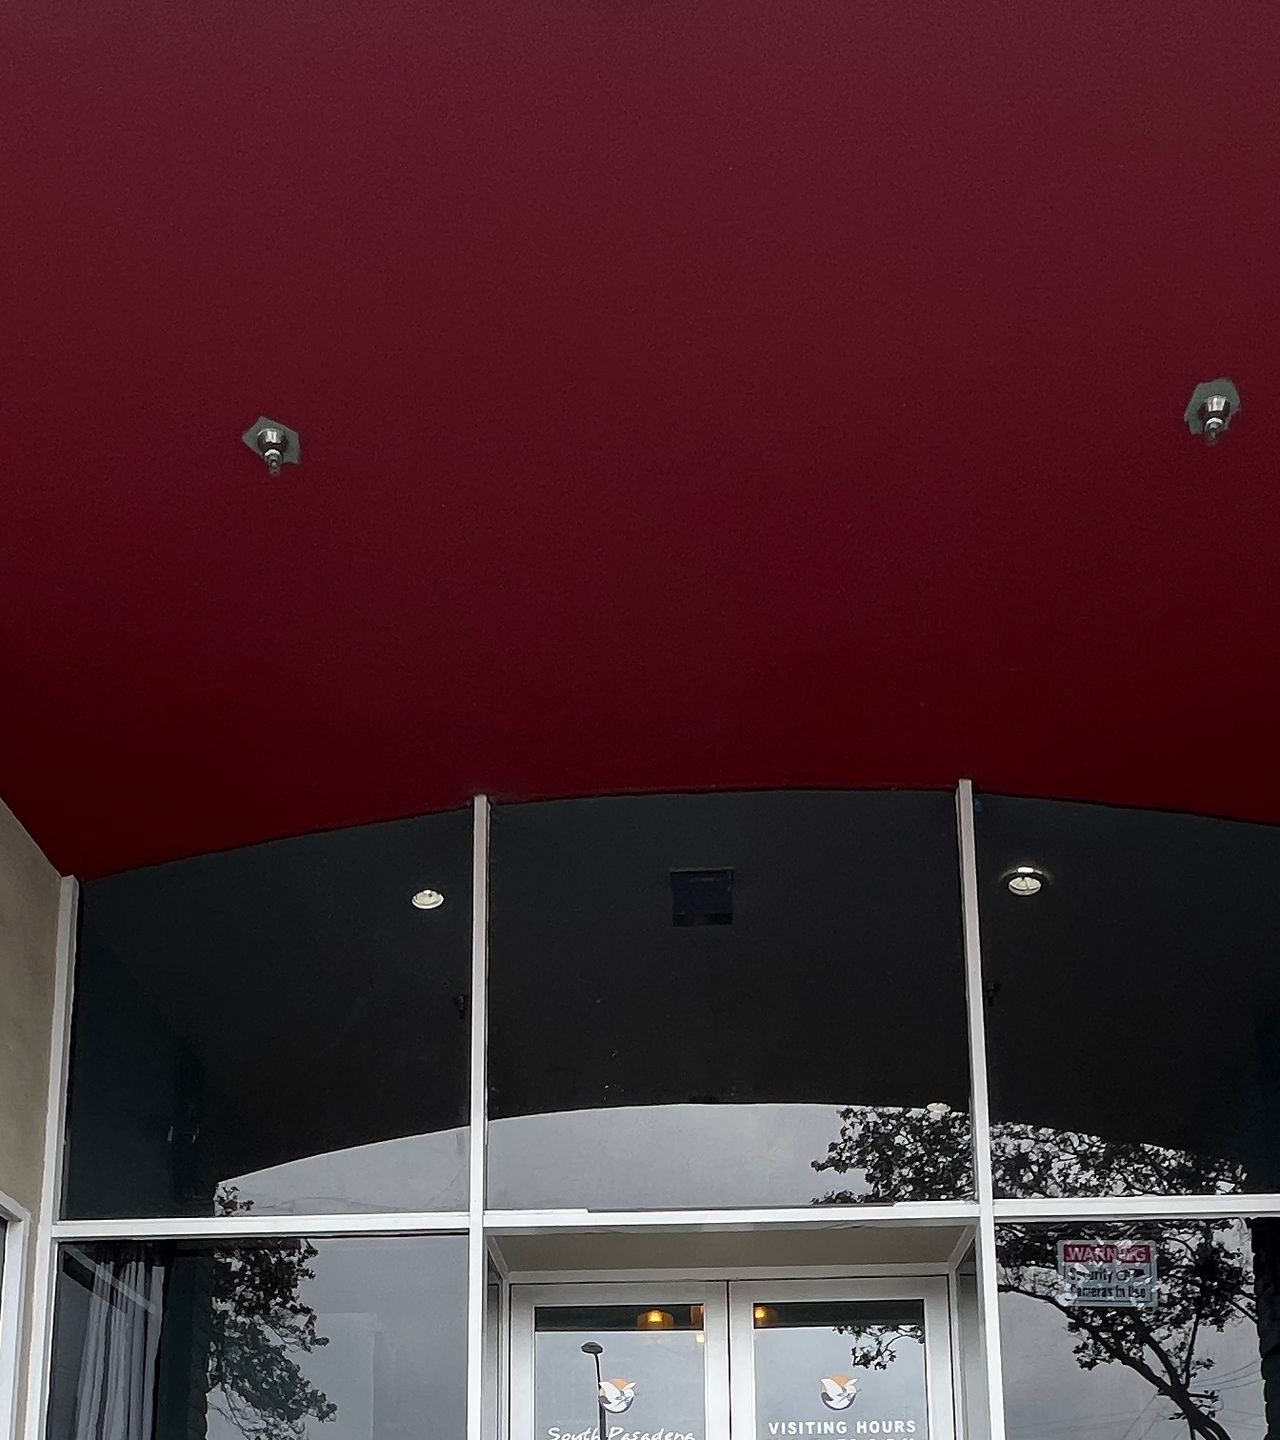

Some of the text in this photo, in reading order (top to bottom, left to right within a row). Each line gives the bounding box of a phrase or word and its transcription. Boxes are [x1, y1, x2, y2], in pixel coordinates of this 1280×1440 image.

[1067, 1246, 1147, 1261] WARNG
[1069, 1268, 1114, 1283] Surity
[768, 1420, 917, 1435] VISITING HOURS
